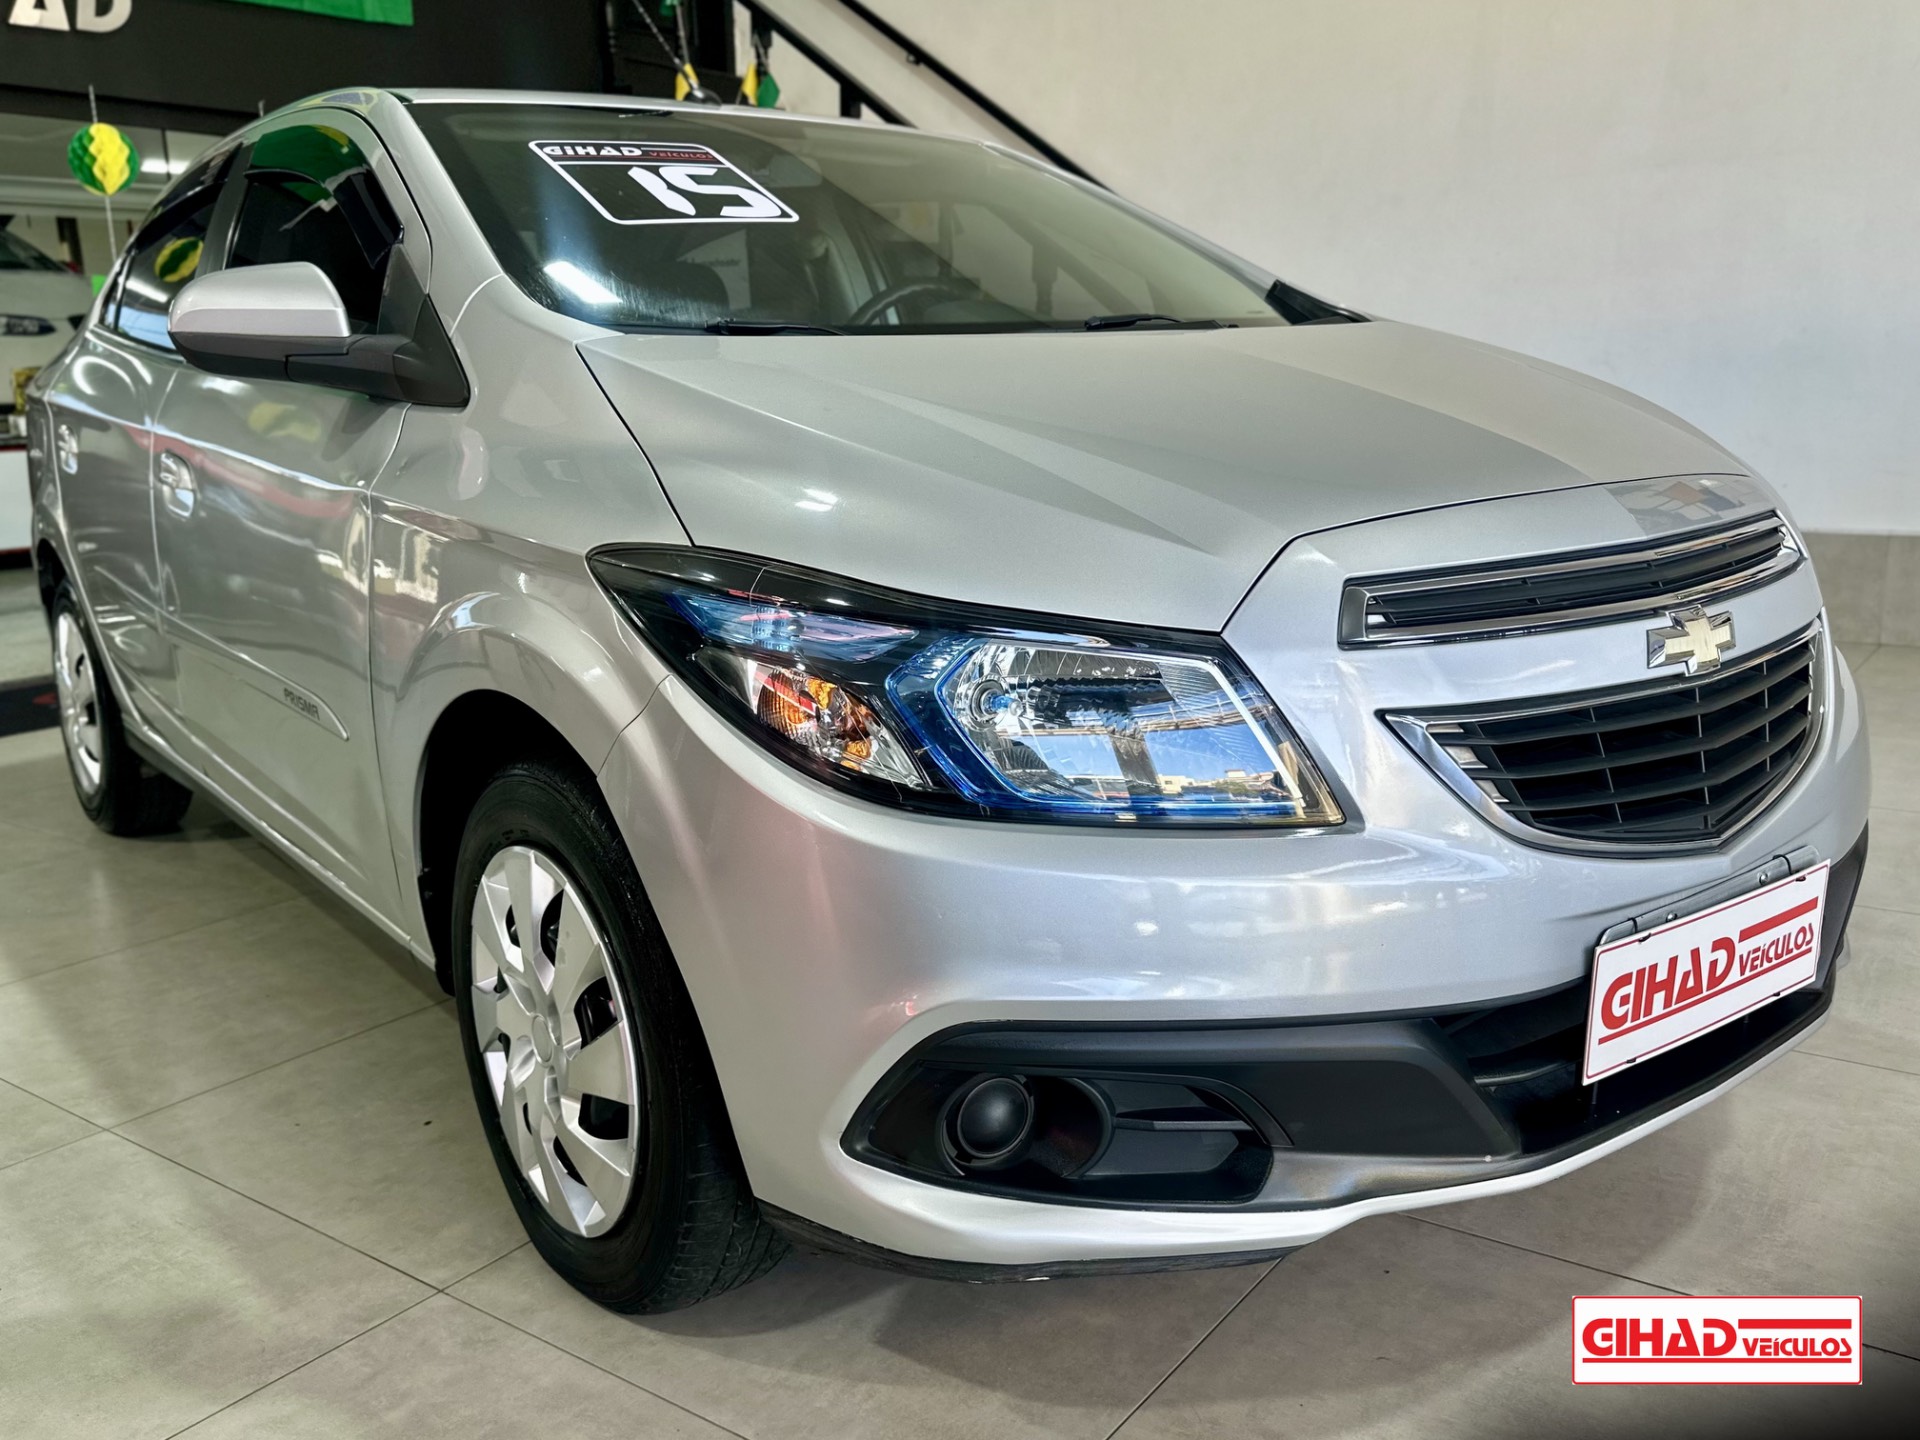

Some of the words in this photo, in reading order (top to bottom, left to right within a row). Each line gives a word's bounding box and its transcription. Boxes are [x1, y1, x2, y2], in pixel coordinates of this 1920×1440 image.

[543, 146, 643, 157] GIHAD
[627, 166, 782, 217] 15
[1601, 936, 1736, 1030] GIHAD
